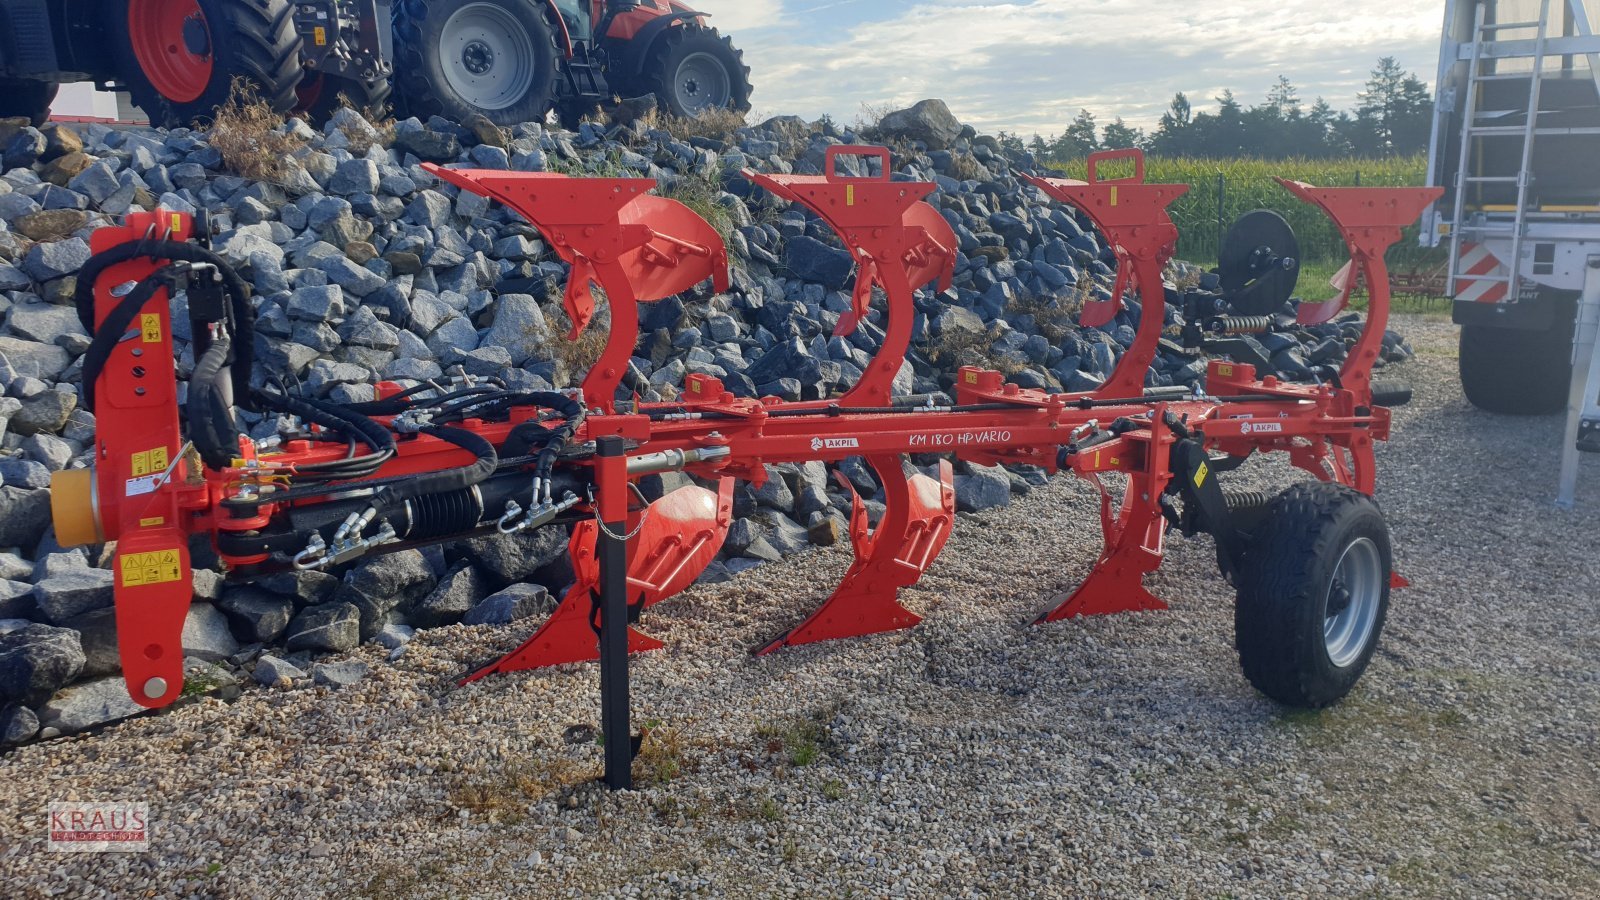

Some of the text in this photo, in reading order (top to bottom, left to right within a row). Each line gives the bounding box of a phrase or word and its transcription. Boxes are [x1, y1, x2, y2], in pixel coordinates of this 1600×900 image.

[1520, 291, 1540, 300] ANT
[828, 439, 855, 447] AKPIL
[909, 434, 927, 446] KM
[931, 433, 954, 445] 180
